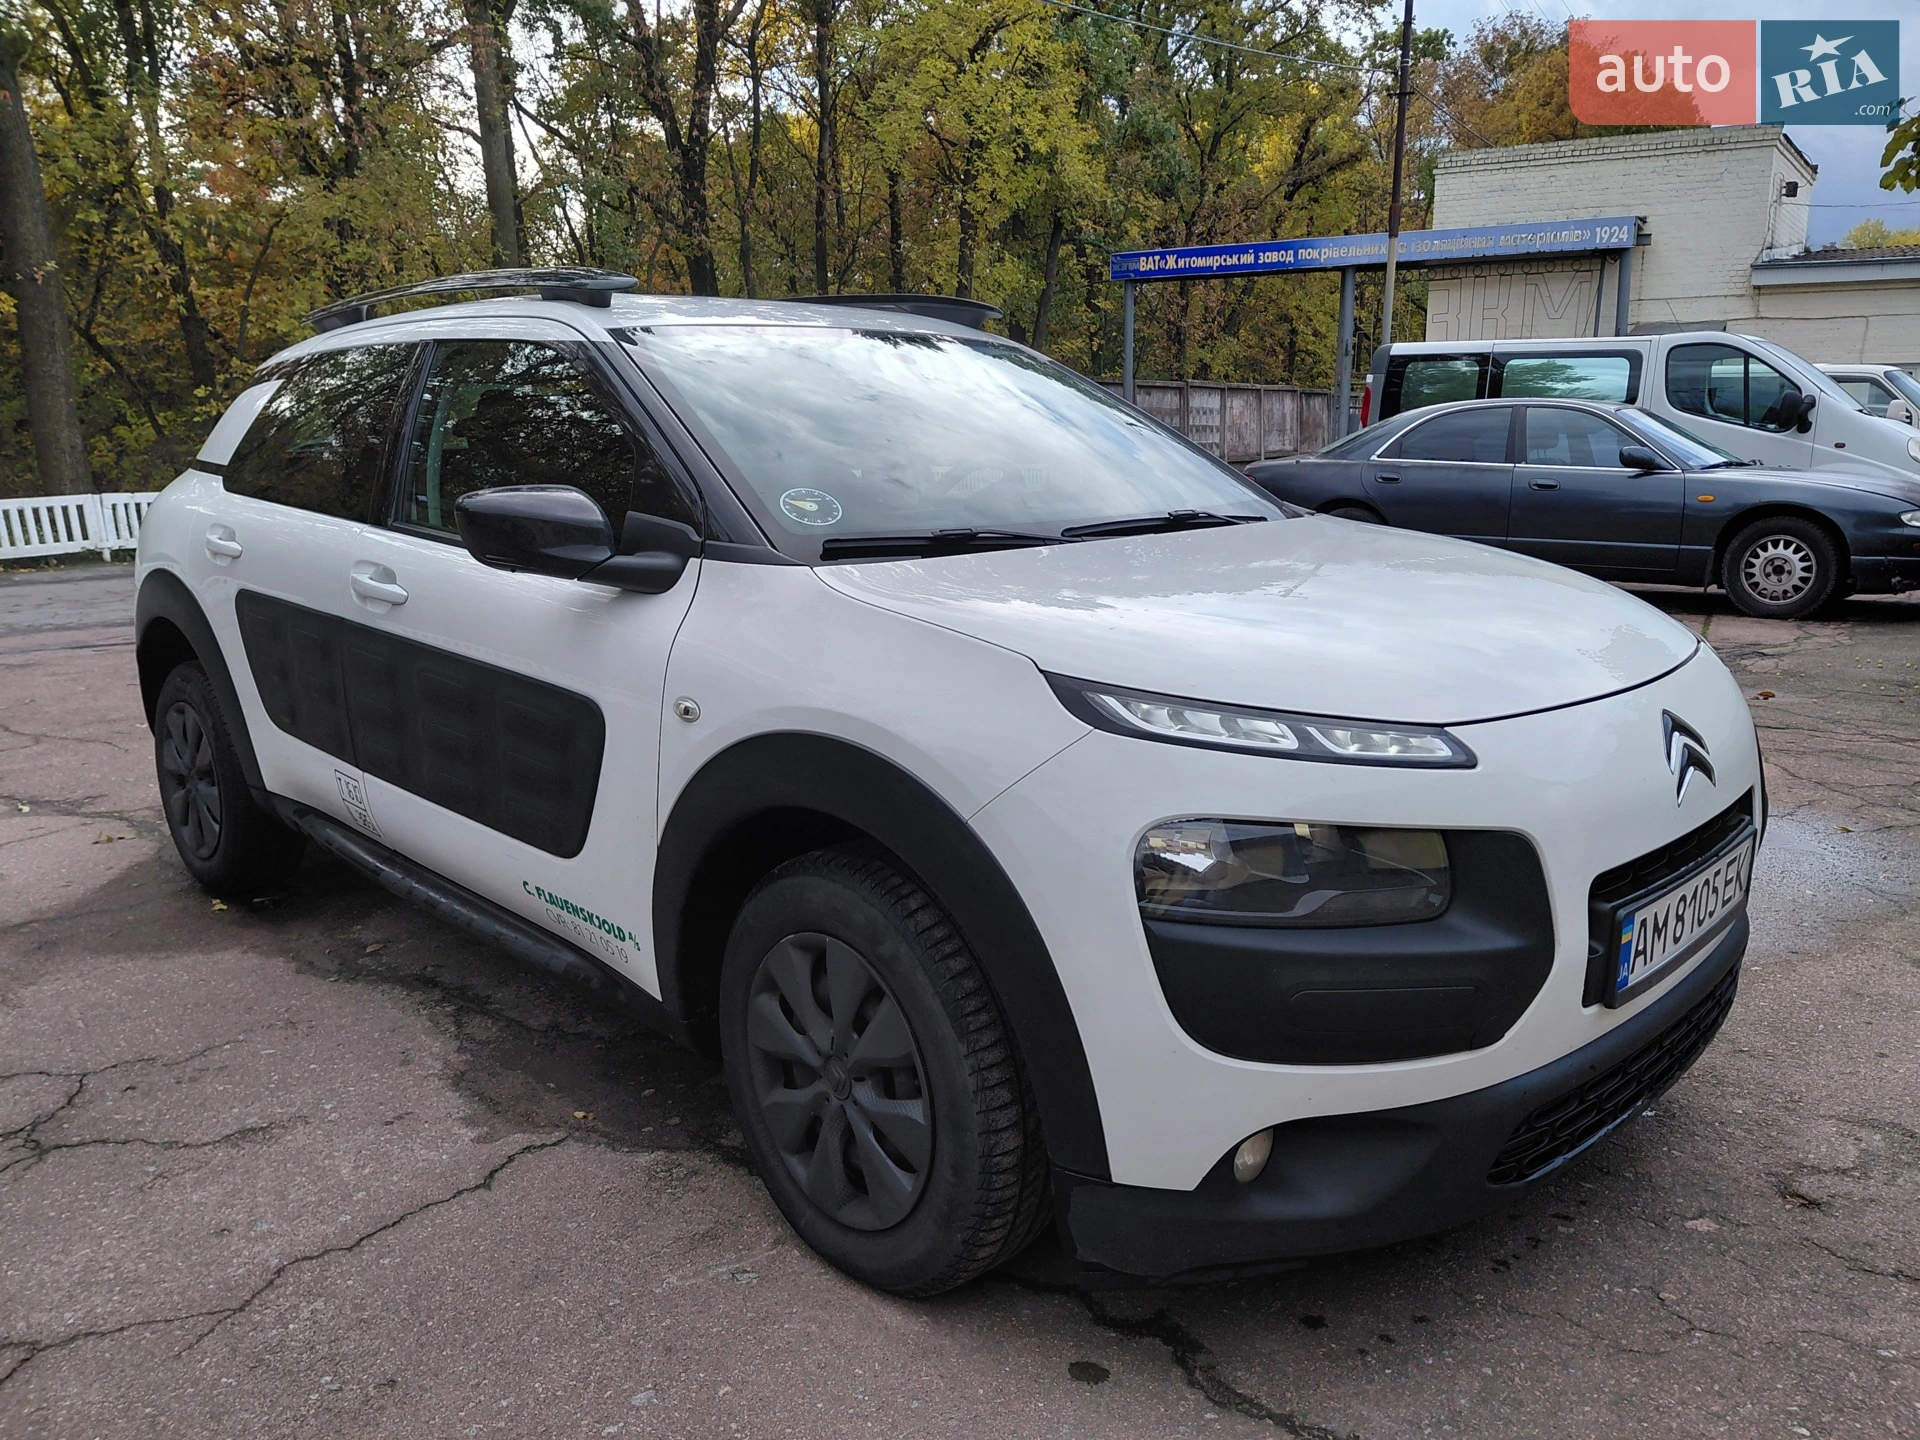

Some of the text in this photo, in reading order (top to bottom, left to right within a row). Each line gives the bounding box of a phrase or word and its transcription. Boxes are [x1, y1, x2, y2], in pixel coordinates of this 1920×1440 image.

[1257, 248, 1294, 264] завод
[1298, 243, 1388, 263] покрівельних
[1595, 225, 1628, 244] 1924
[522, 880, 536, 898] C.
[535, 885, 627, 943] FLAUENSKJOLD
[599, 935, 615, 956] 05
[615, 944, 629, 964] 19
